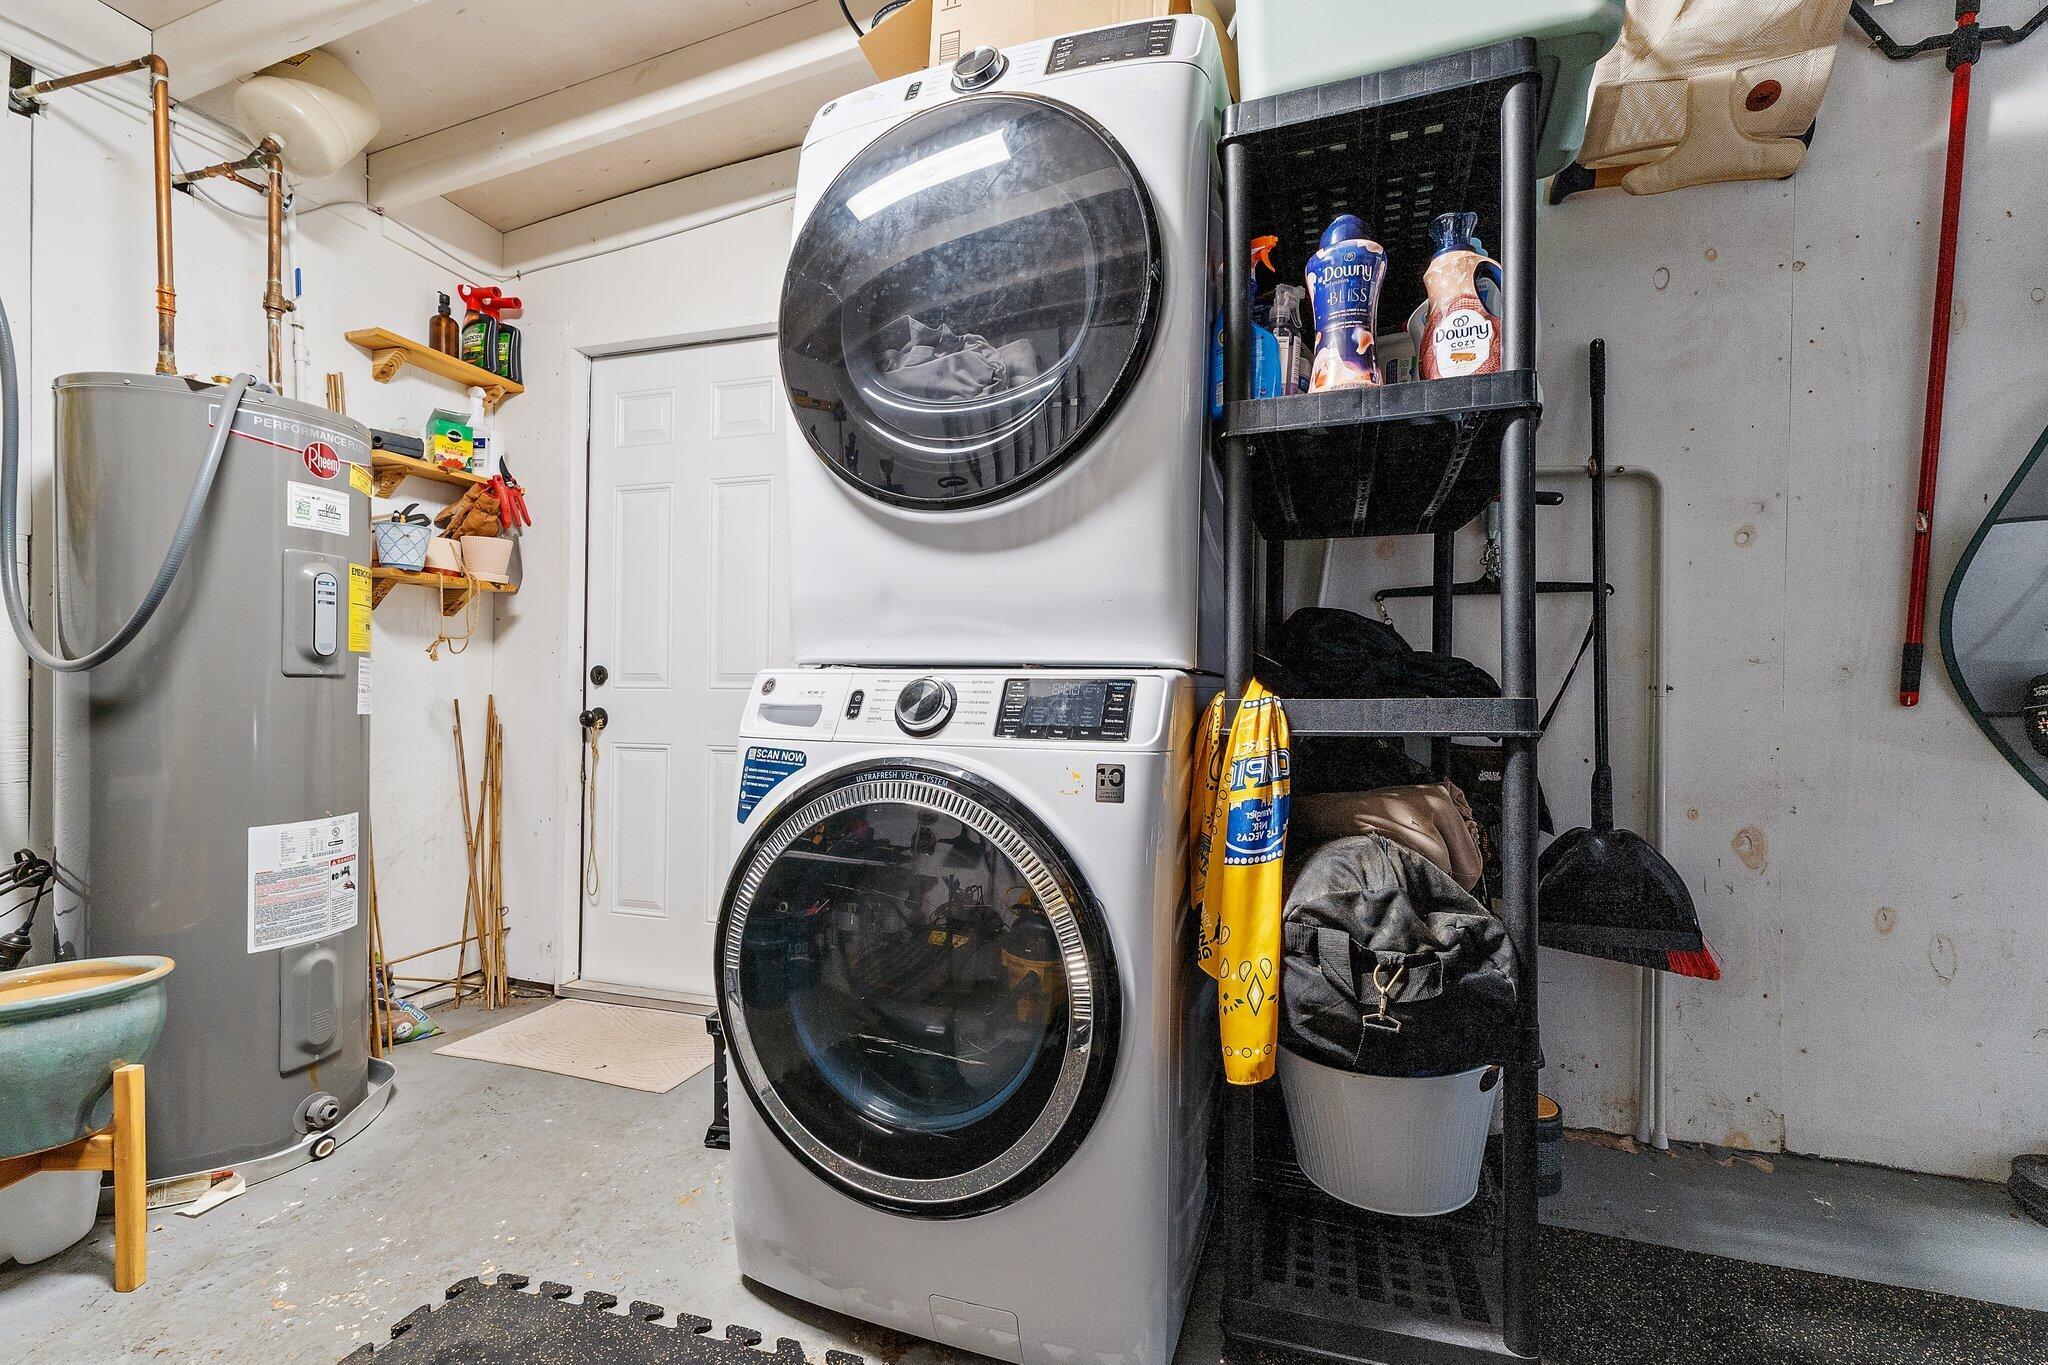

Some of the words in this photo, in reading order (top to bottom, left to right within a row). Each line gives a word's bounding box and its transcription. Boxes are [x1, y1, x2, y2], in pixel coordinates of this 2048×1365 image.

[1323, 264, 1372, 283] Downy
[1327, 288, 1367, 306] BLISS
[1436, 323, 1489, 343] Downy
[1450, 339, 1476, 348] COZY
[253, 416, 347, 447] PERFORMANCE
[308, 442, 338, 474] Rheem
[756, 749, 780, 760] SCAN
[781, 751, 805, 763] NOW
[856, 771, 898, 783] ULTRAFRESH
[901, 771, 919, 780] VENT
[922, 774, 949, 787] SYSTEM
[1097, 768, 1124, 787] 10
